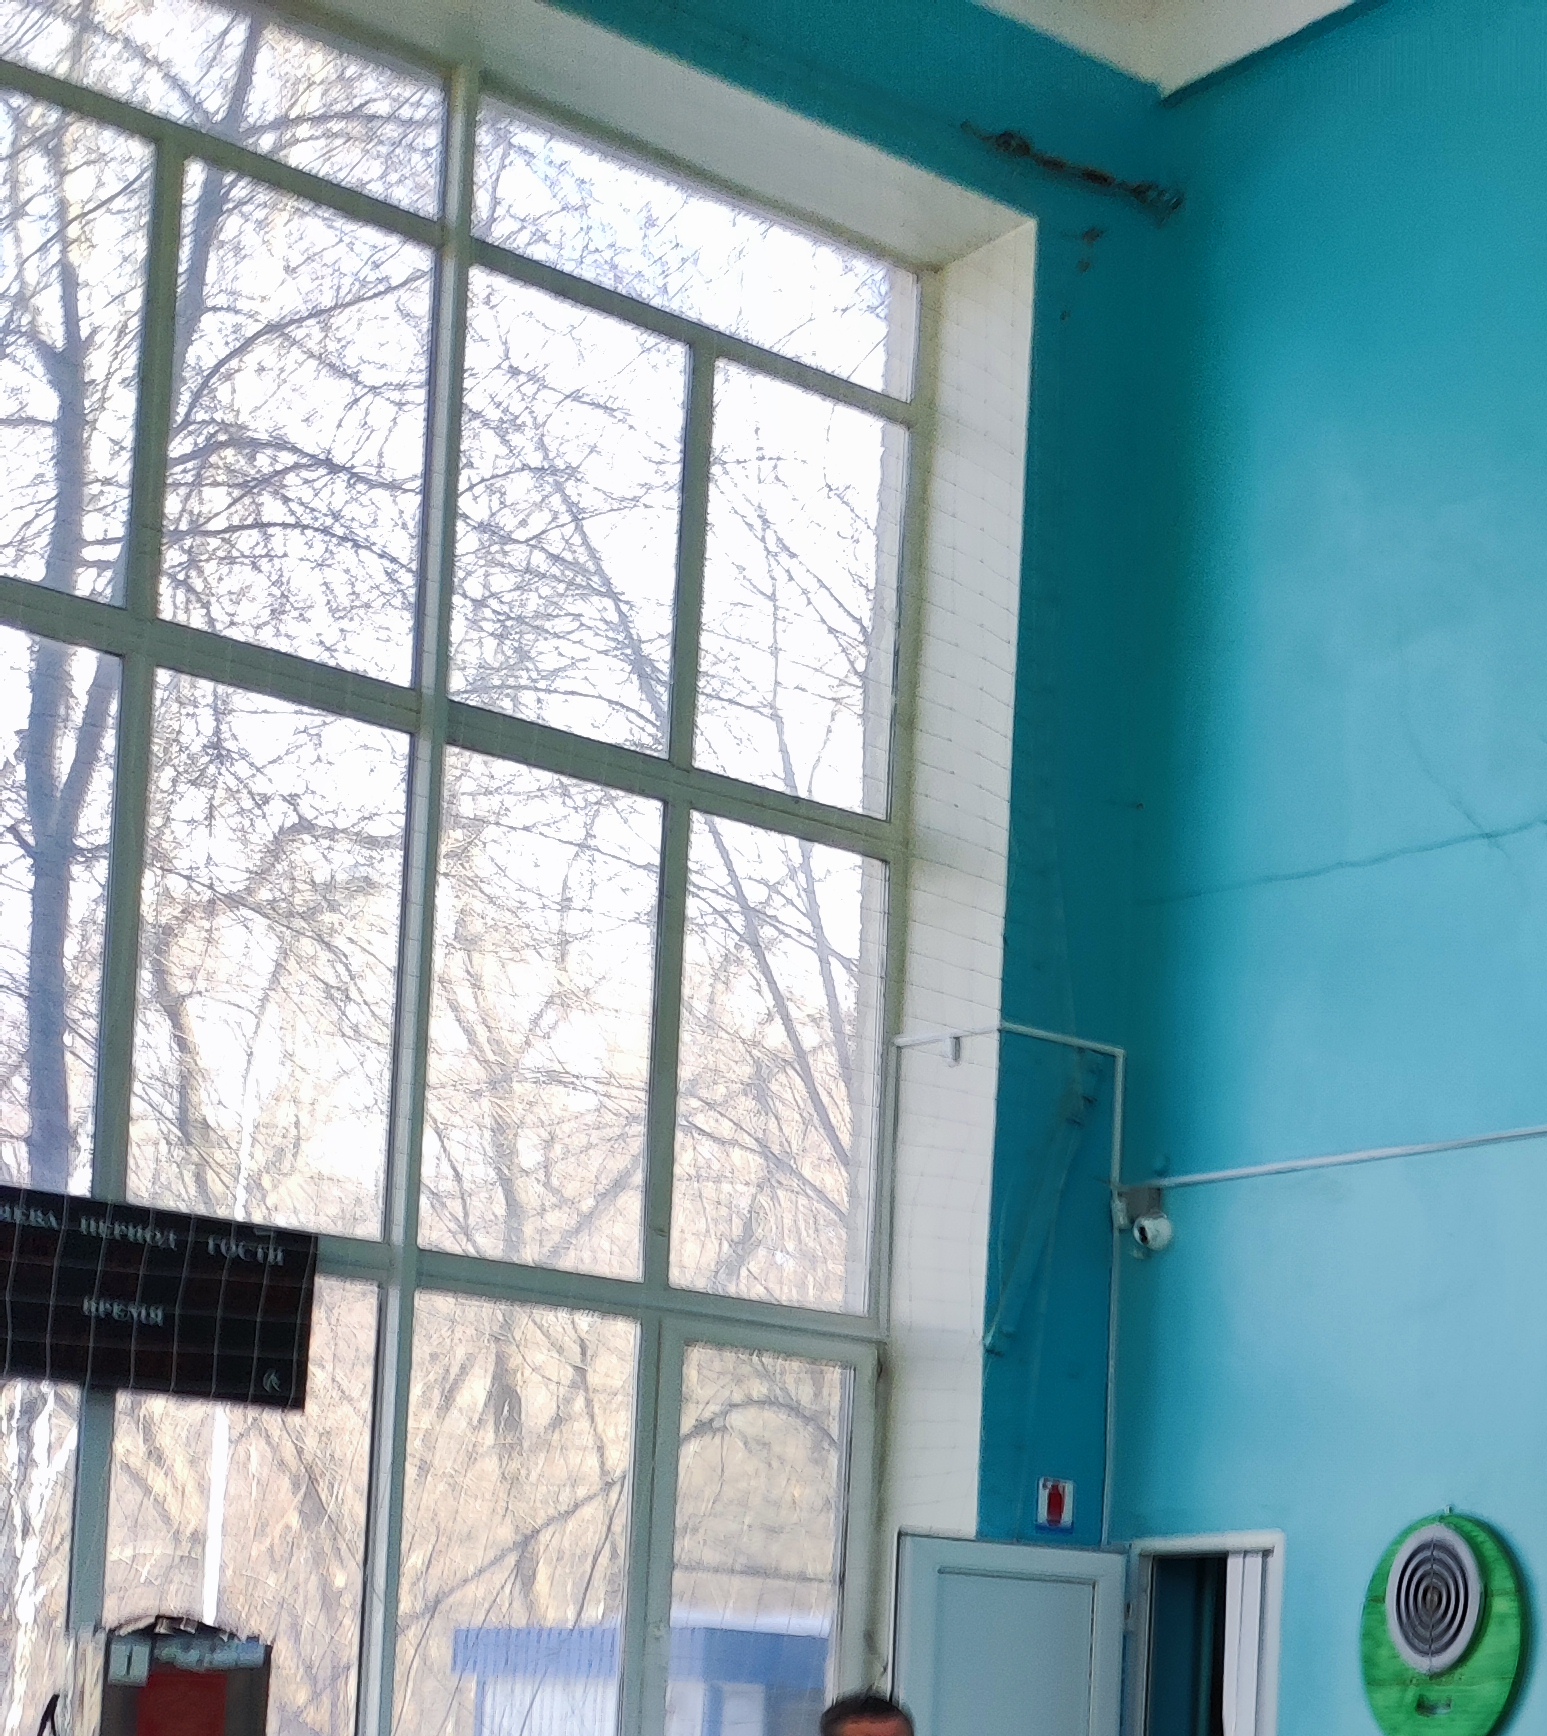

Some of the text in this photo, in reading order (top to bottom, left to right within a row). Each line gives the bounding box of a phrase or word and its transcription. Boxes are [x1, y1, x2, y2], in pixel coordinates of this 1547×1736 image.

[0, 1202, 285, 1267] ЯЕВА ПЕРИОД ГОСТИ
[82, 1296, 164, 1327] ВРЕМЯ
